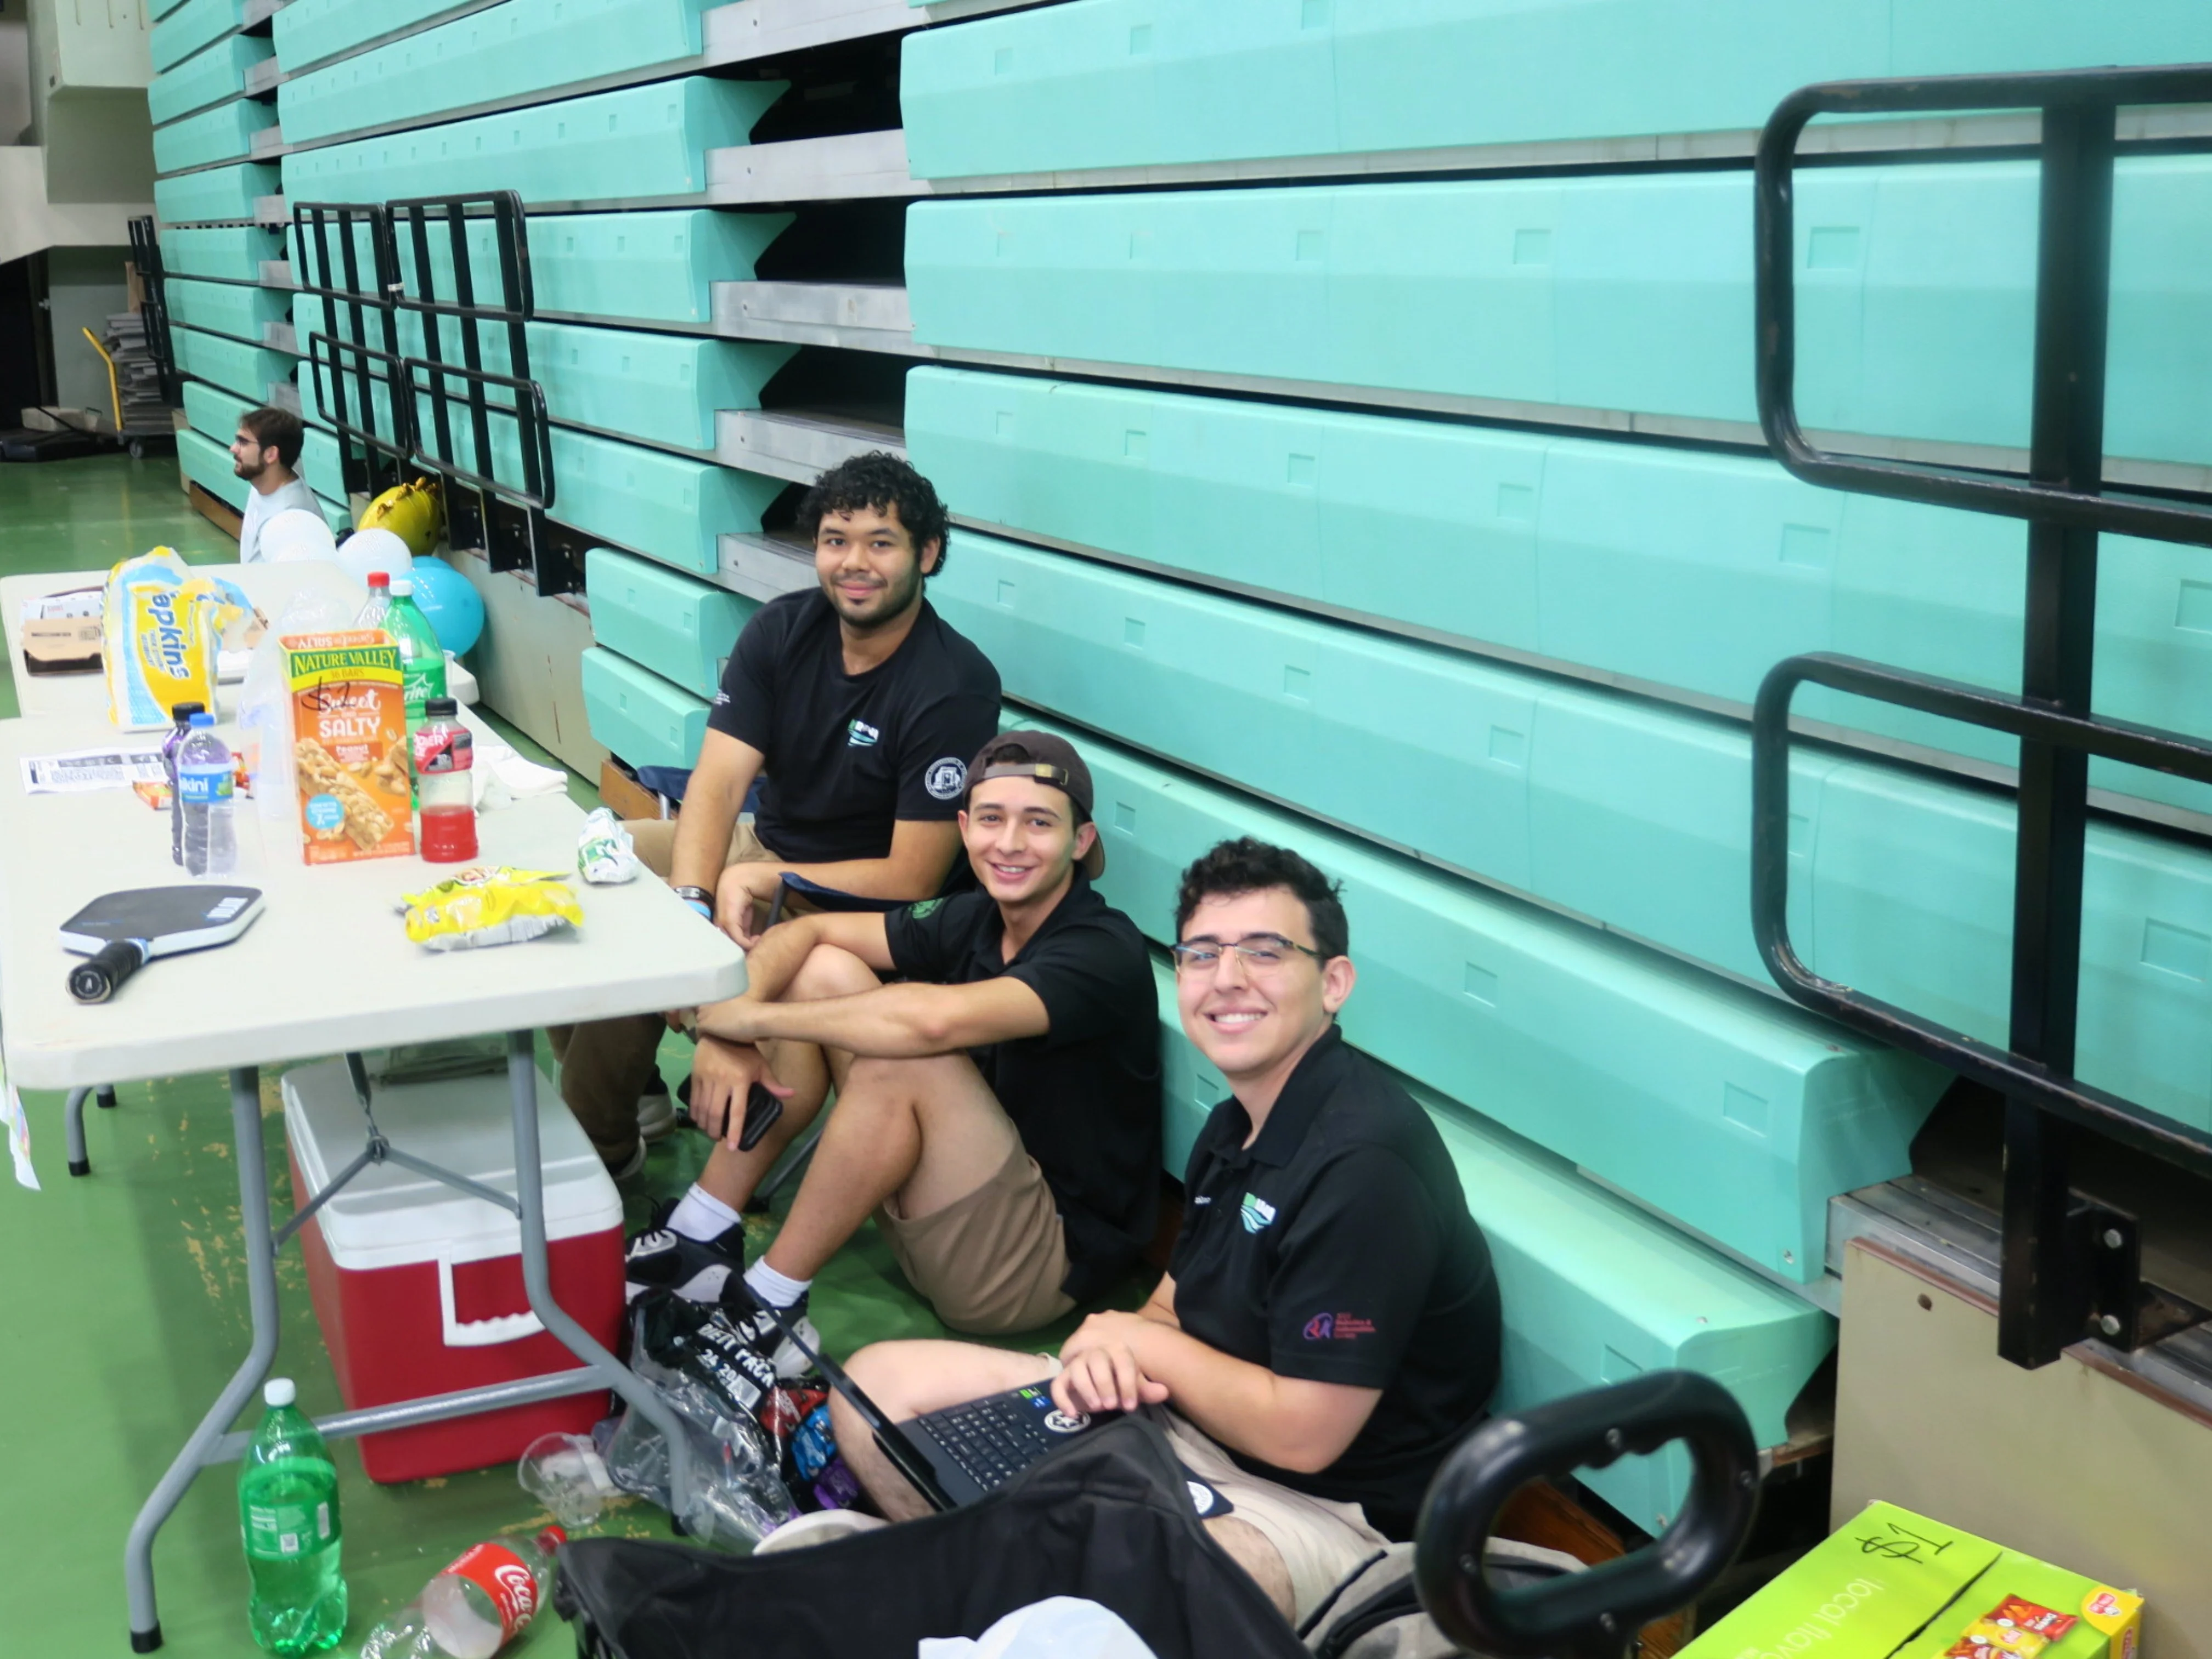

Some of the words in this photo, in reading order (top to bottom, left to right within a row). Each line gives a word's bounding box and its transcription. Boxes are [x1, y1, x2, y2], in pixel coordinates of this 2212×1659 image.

[149, 591, 190, 679] apkins
[294, 653, 348, 676] NATURE
[348, 649, 397, 669] VALLEY
[342, 668, 365, 678] BARS
[301, 676, 356, 711] $2
[319, 689, 381, 715] Sweet
[319, 716, 381, 738] SALTY
[1855, 1522, 1954, 1564] $1
[1812, 1577, 1885, 1627] local
